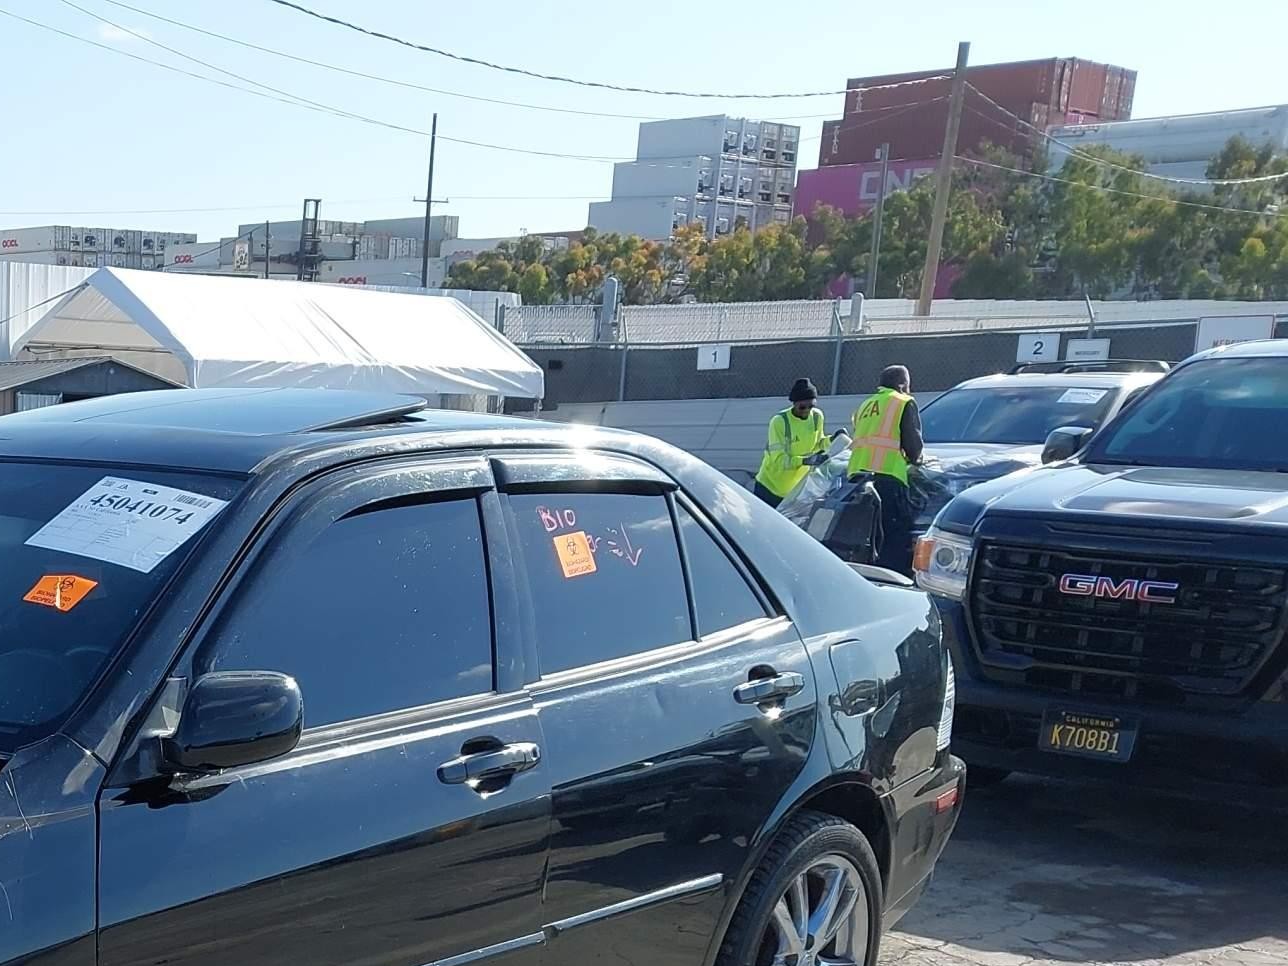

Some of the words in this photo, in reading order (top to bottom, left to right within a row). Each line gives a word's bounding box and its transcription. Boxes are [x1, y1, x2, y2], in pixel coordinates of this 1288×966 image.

[711, 350, 718, 363] 1
[1032, 341, 1044, 355] 2
[90, 493, 195, 525] 45041074
[536, 505, 576, 532] BIO
[1059, 573, 1179, 604] GMC
[1065, 714, 1115, 728] CALIFORNIA
[1051, 723, 1120, 754] K708B1
